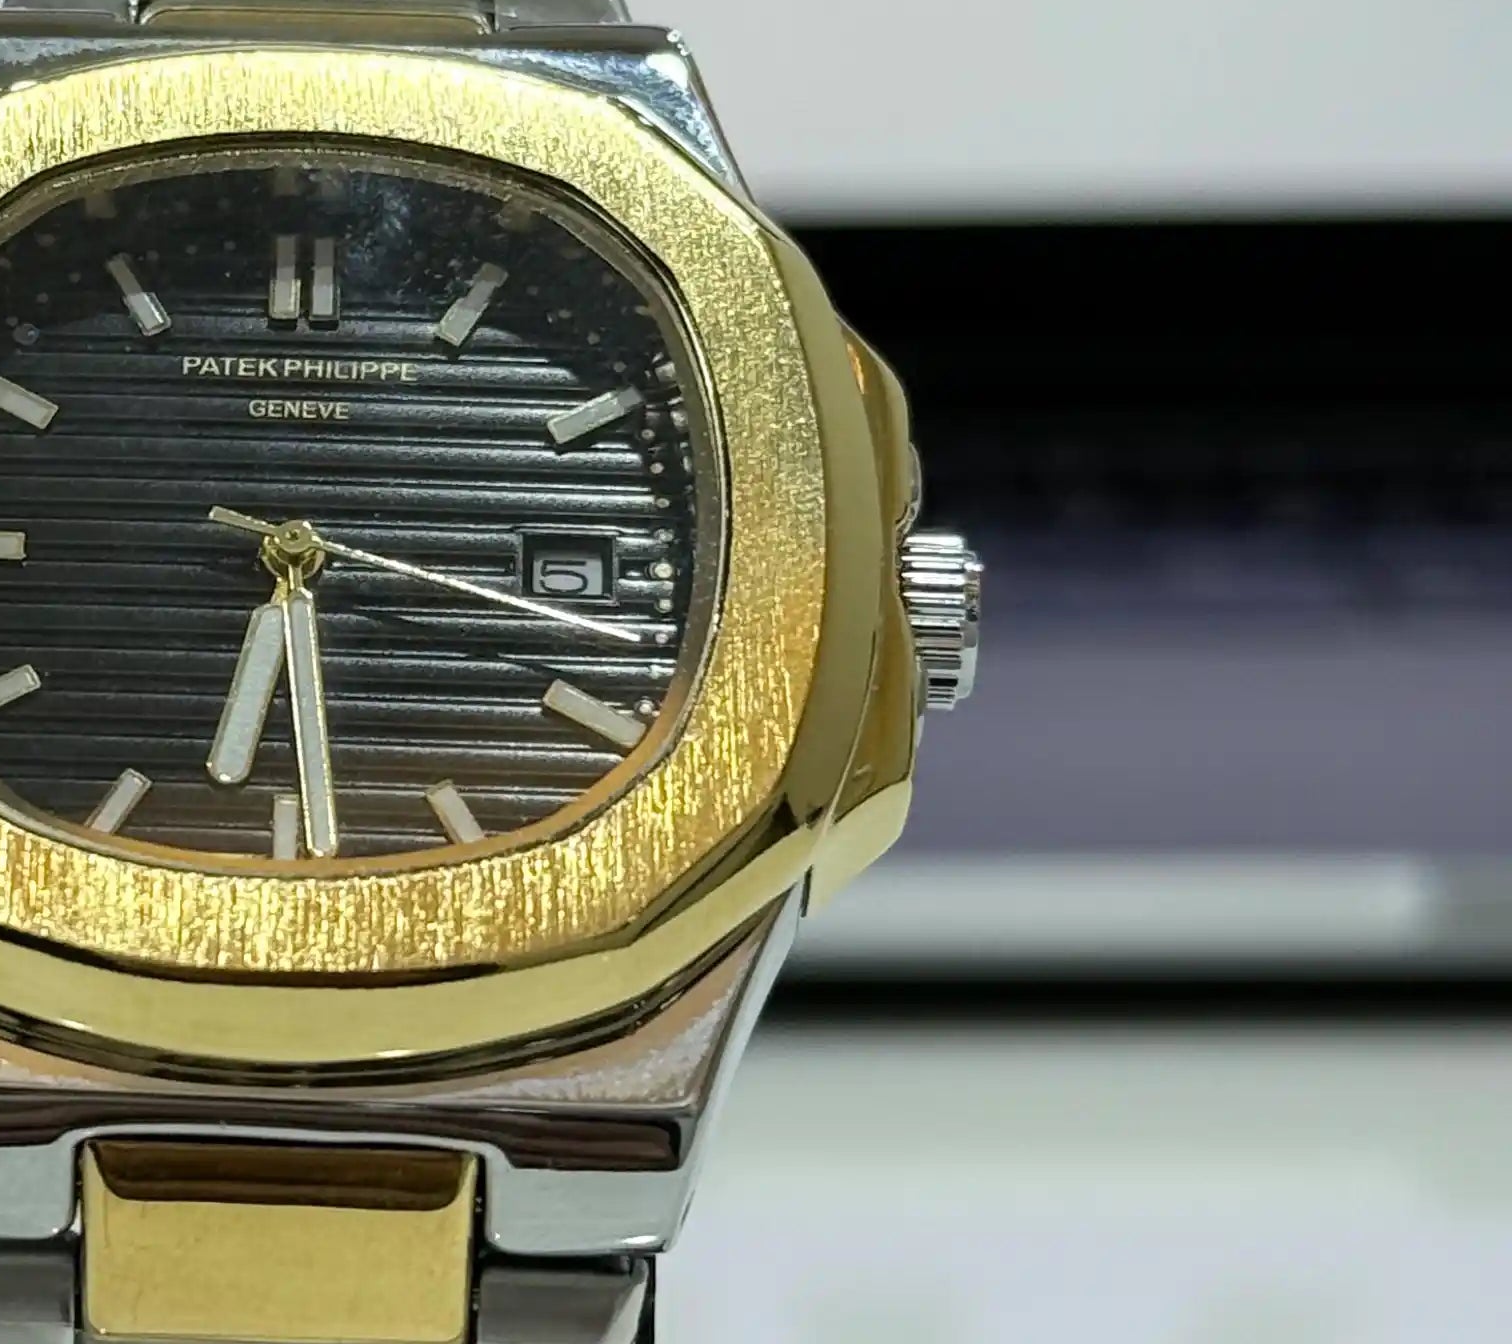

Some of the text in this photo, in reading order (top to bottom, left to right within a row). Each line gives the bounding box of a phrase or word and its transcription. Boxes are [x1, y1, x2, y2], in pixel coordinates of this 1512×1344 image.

[181, 355, 419, 382] PATEK PHILIPPE
[248, 399, 351, 420] GENEVE
[540, 559, 588, 593] 5
